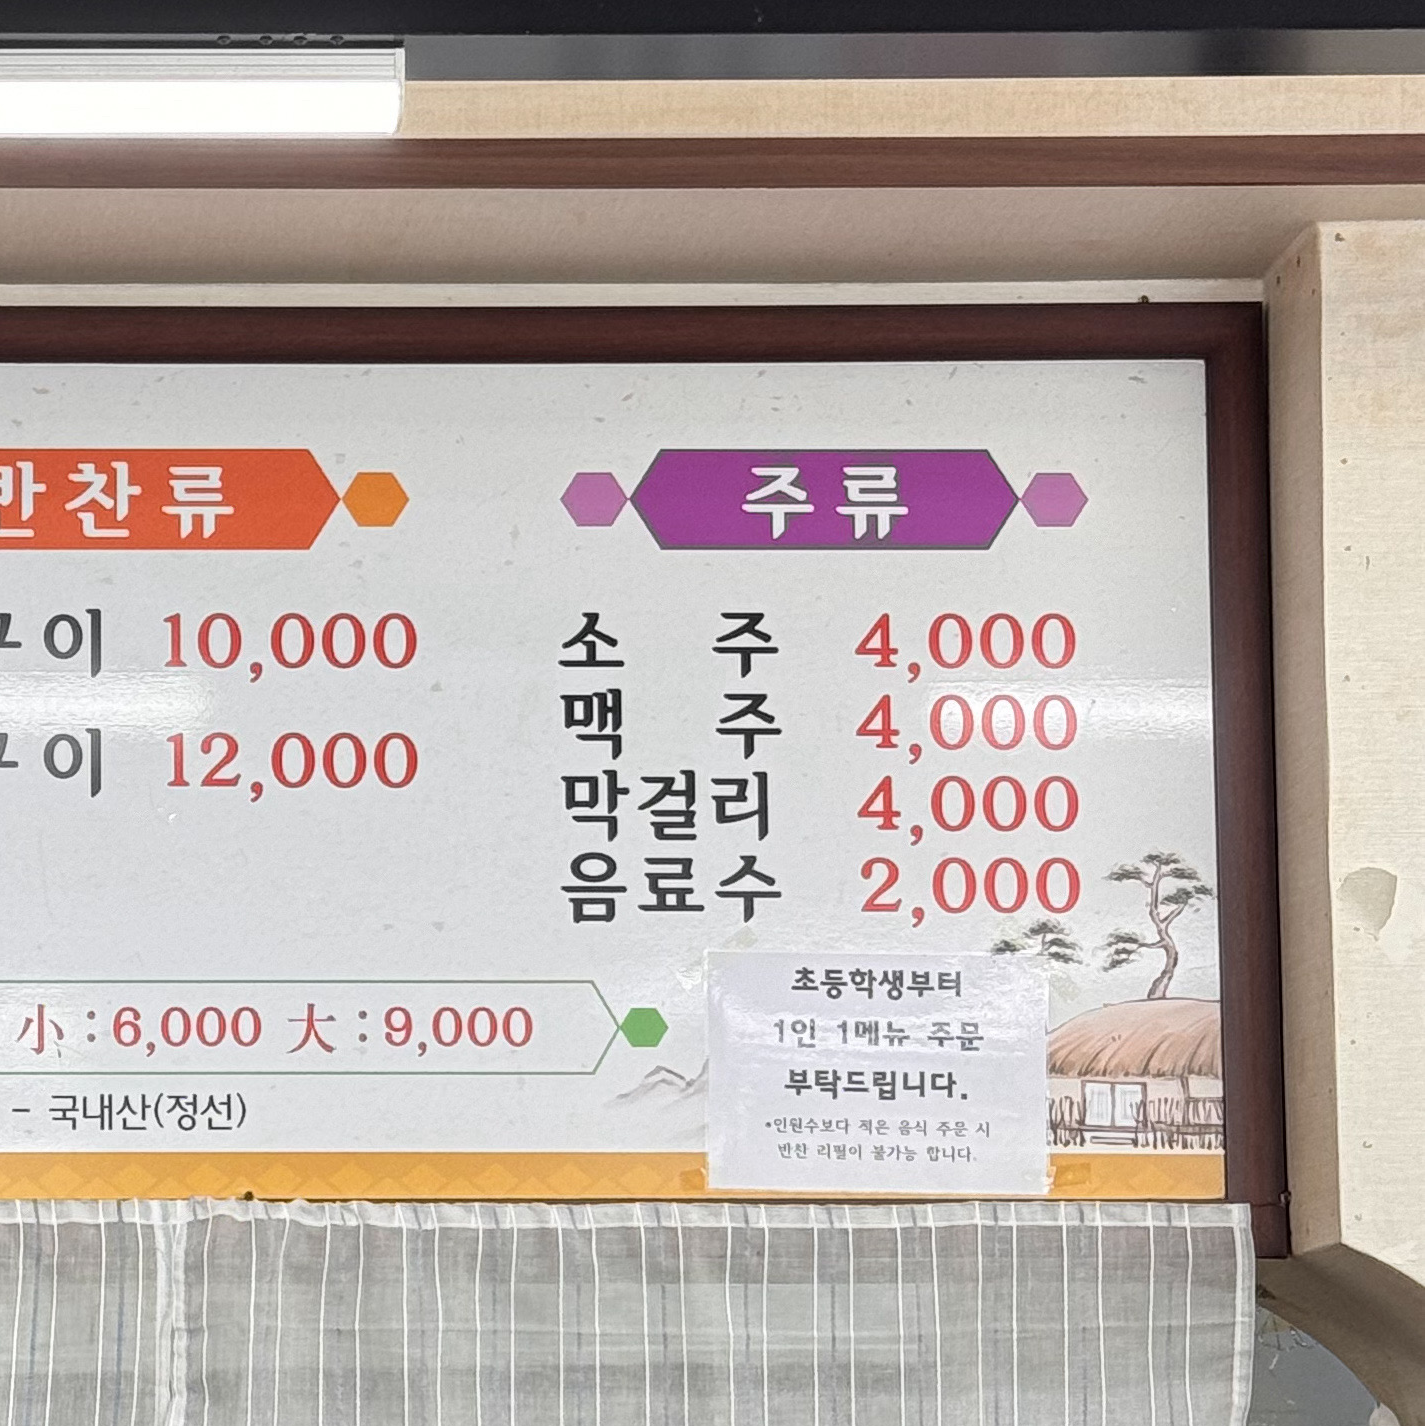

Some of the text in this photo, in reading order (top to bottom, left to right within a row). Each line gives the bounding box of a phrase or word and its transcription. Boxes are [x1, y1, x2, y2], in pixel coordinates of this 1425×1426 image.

[164, 612, 418, 683] 10,000
[855, 612, 1077, 682] 4,000
[855, 694, 1077, 764] 4,000
[166, 732, 419, 803] 12,000
[561, 770, 1080, 846] 막걸리 4,000
[561, 852, 1081, 928] 음료수 2,000
[791, 967, 960, 1000] 초등학생부터
[774, 1019, 984, 1051] 1인 1메뉴 주문
[49, 1093, 246, 1131] 국내산(정선)
[785, 1070, 967, 1100] 부탁드립니다.
